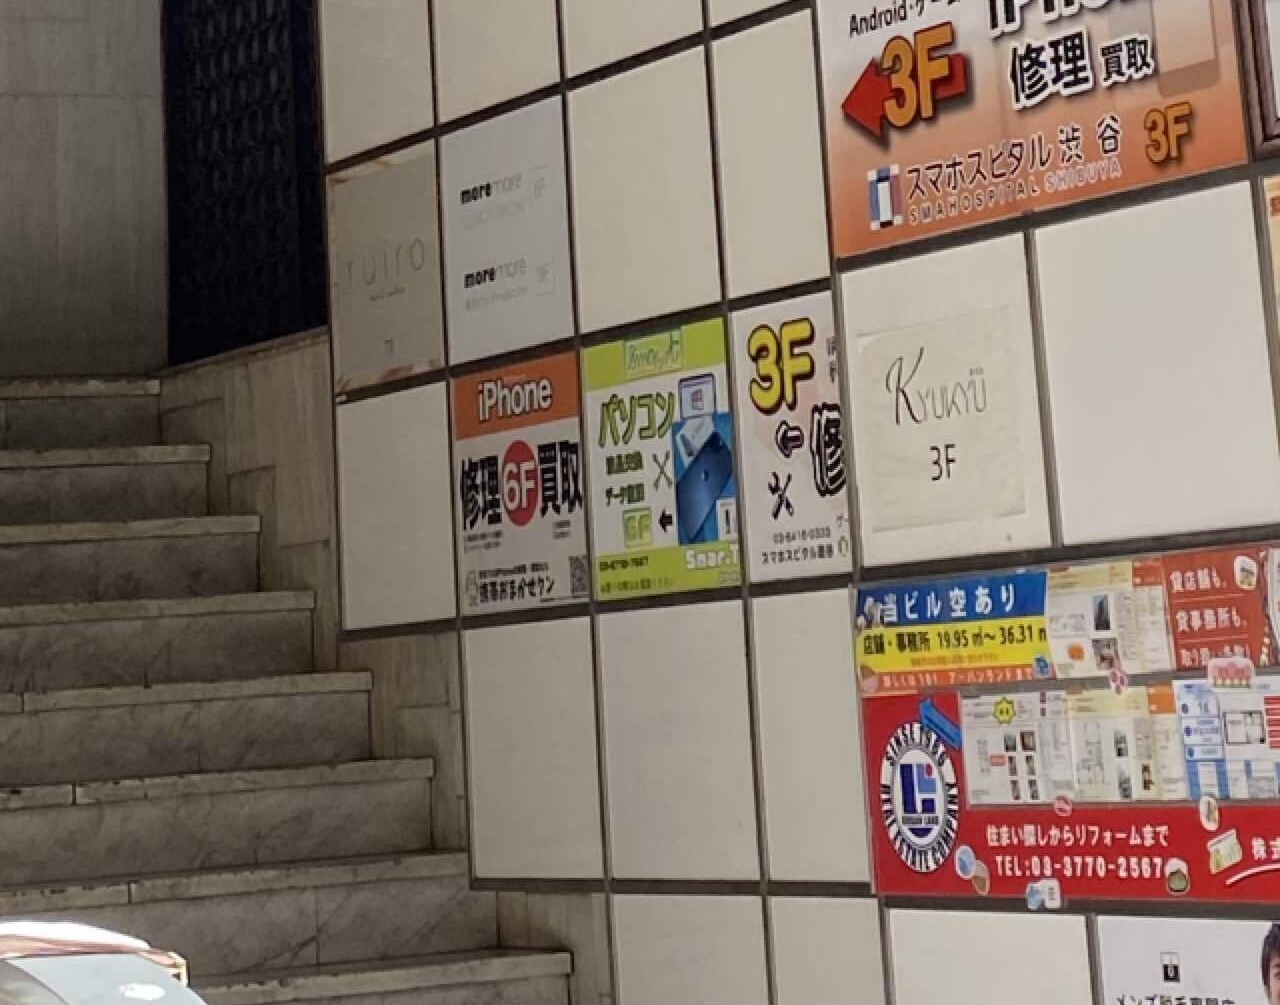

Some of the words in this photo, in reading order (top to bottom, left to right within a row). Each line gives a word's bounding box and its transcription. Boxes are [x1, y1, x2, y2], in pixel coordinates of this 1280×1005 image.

[879, 21, 954, 128] 3F
[1010, 30, 1091, 104] 修理
[1100, 35, 1155, 82] 買取
[1144, 101, 1193, 164] 3F
[906, 134, 1053, 201] スマホスピタル
[748, 316, 816, 416] 3F
[478, 378, 553, 421] iPhone
[597, 391, 676, 448] パソコン
[460, 455, 503, 531] 修理
[503, 462, 537, 511] 6F
[537, 439, 583, 518] 買取
[929, 443, 957, 482] 3F
[985, 824, 1170, 848] 住まい探しからリフォームまで
[995, 855, 1164, 879] TEL:03-3770-2567
